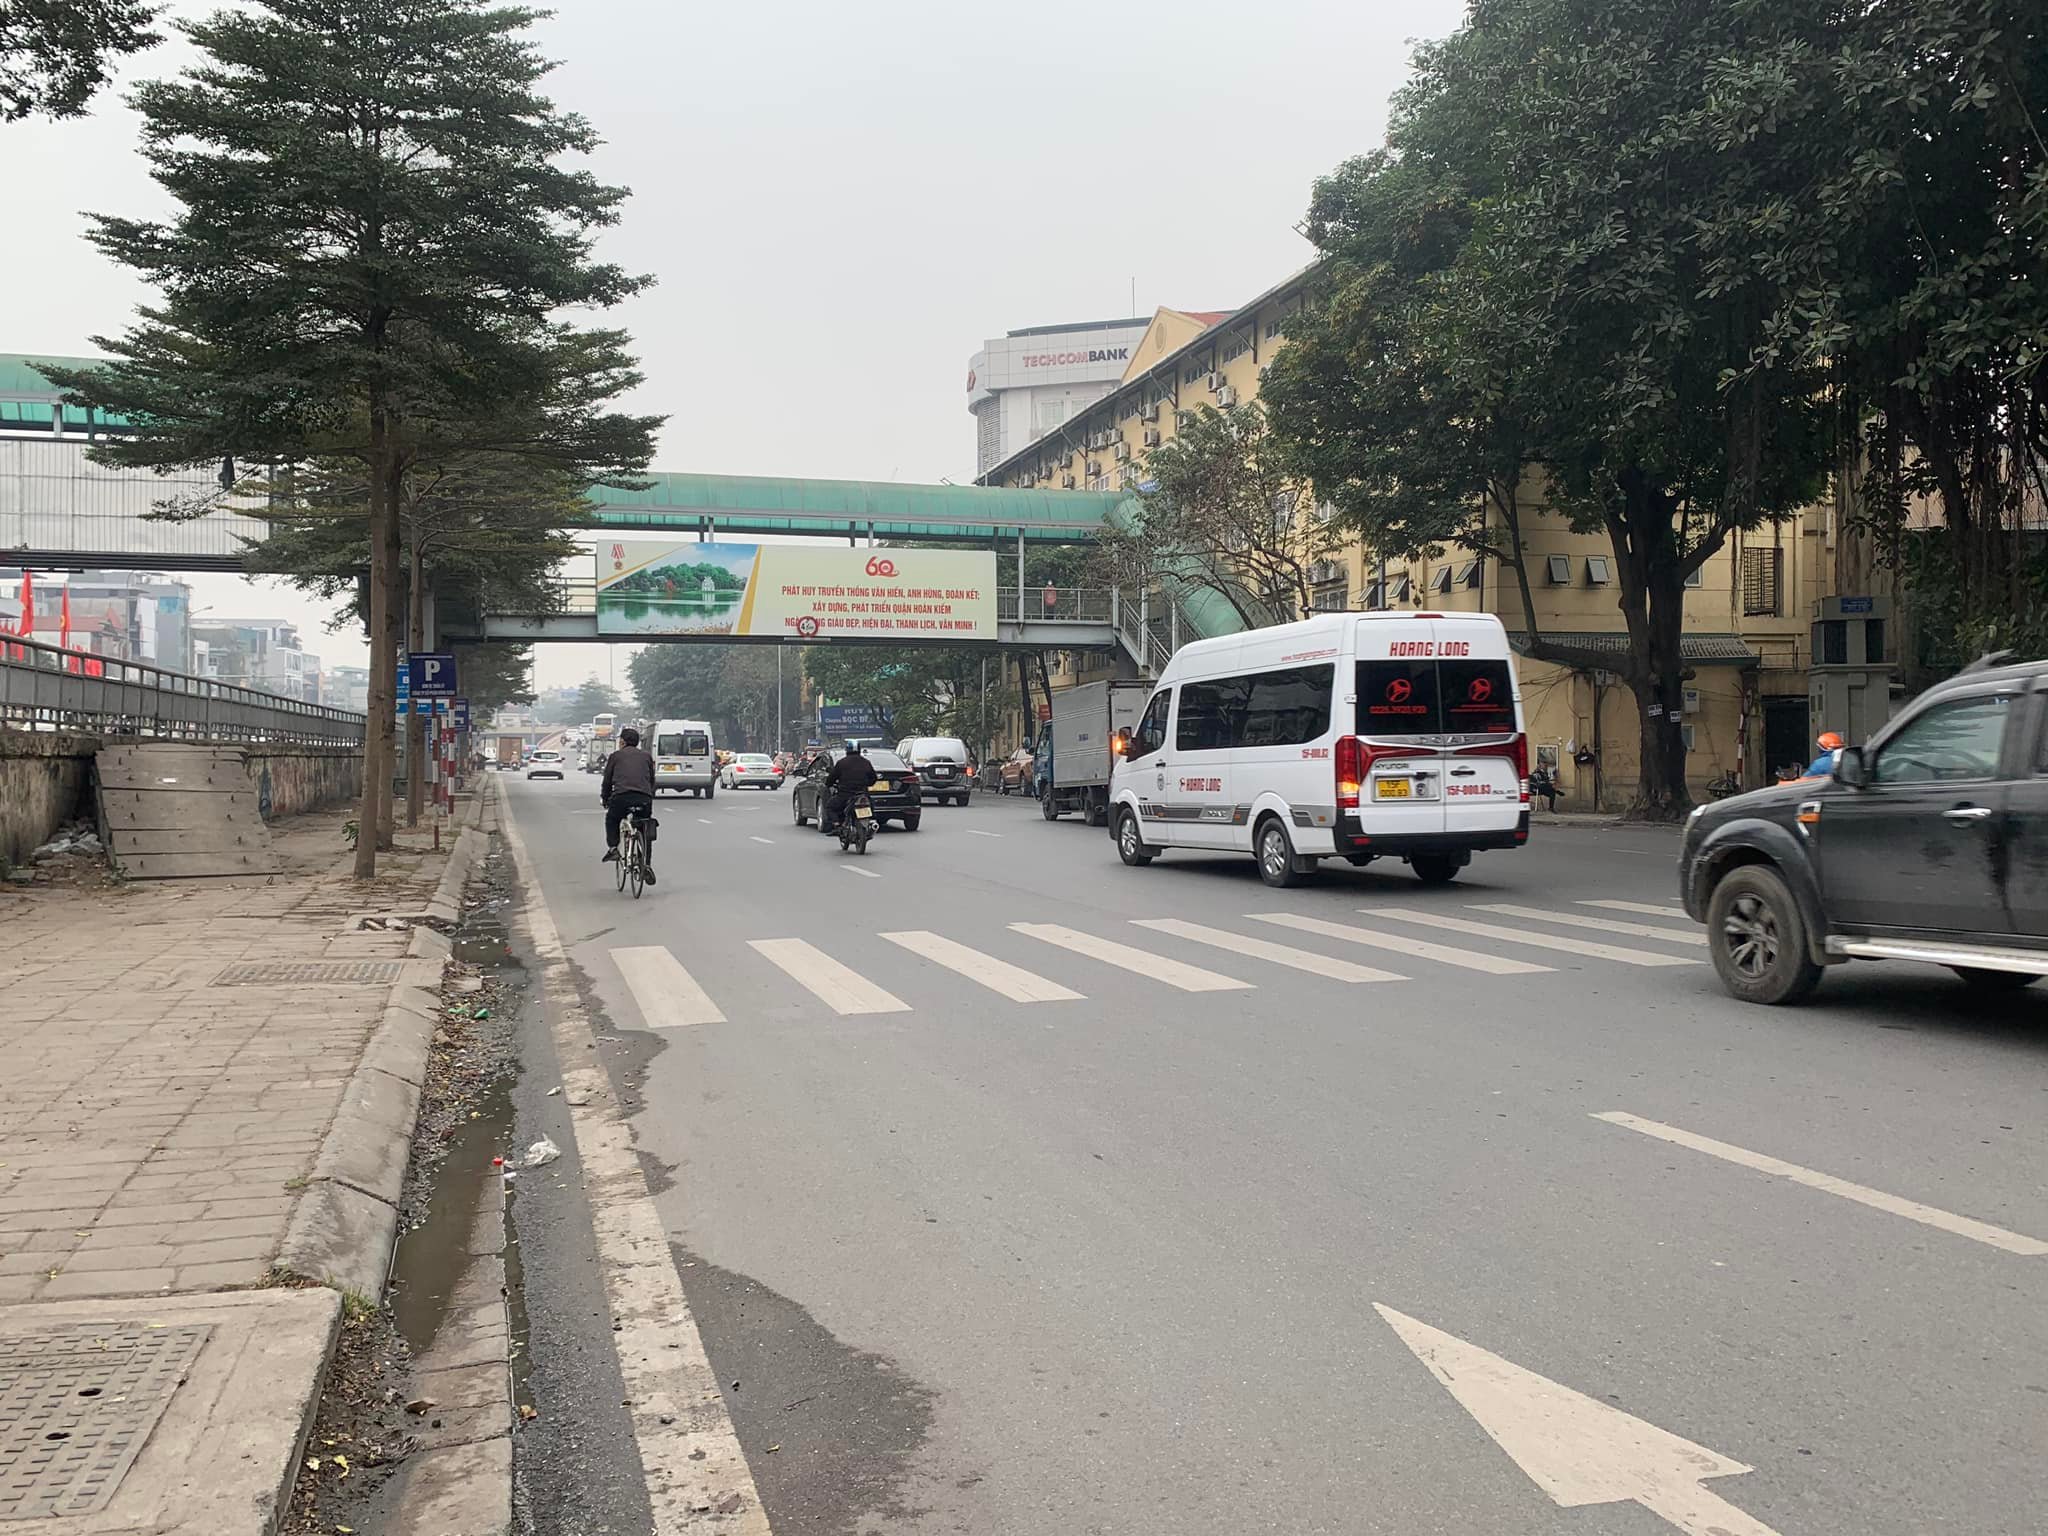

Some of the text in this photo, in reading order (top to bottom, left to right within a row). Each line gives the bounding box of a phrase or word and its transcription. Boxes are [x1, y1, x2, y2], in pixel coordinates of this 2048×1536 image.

[1022, 348, 1128, 367] TECHCOMBANK
[865, 556, 899, 577] 60
[802, 586, 816, 596] HUY
[907, 588, 921, 598] ANH
[896, 620, 918, 629] THANH
[1438, 641, 1469, 656] LONG
[425, 660, 440, 681] P
[1206, 778, 1221, 791] LONG
